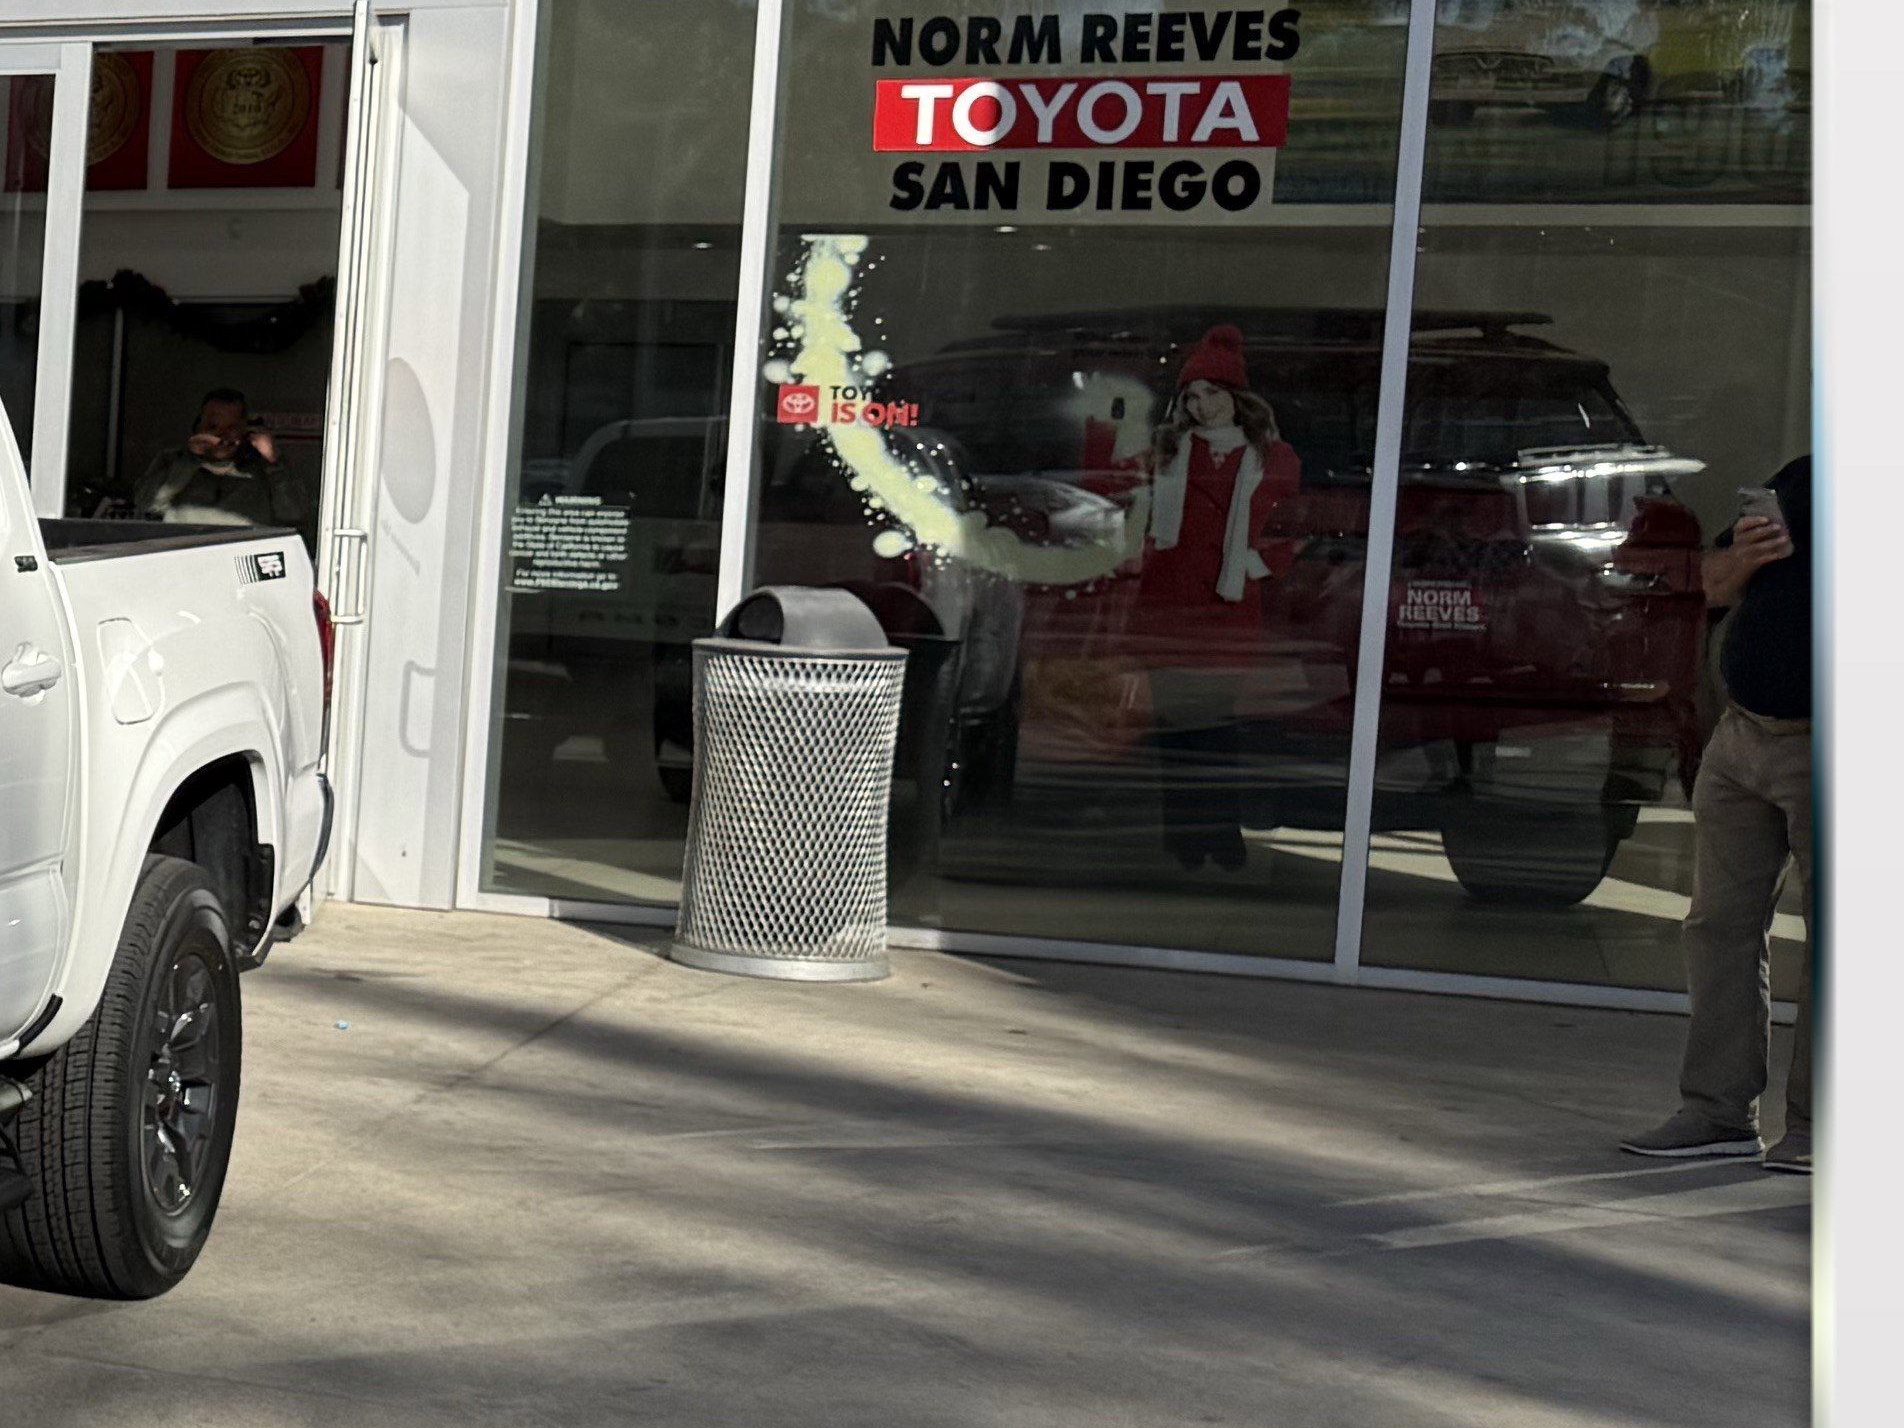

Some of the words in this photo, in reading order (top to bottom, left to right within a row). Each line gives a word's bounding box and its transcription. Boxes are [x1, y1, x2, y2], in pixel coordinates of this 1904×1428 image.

[872, 14, 1062, 66] NORM
[1080, 9, 1302, 62] REEVES
[900, 80, 1261, 146] TOYOTA
[889, 160, 1021, 211] SAN
[1046, 159, 1262, 211] DIEGO
[830, 402, 857, 423] IS
[862, 401, 921, 428] ON!
[1399, 605, 1479, 623] REEVES
[1407, 589, 1472, 605] NORM
